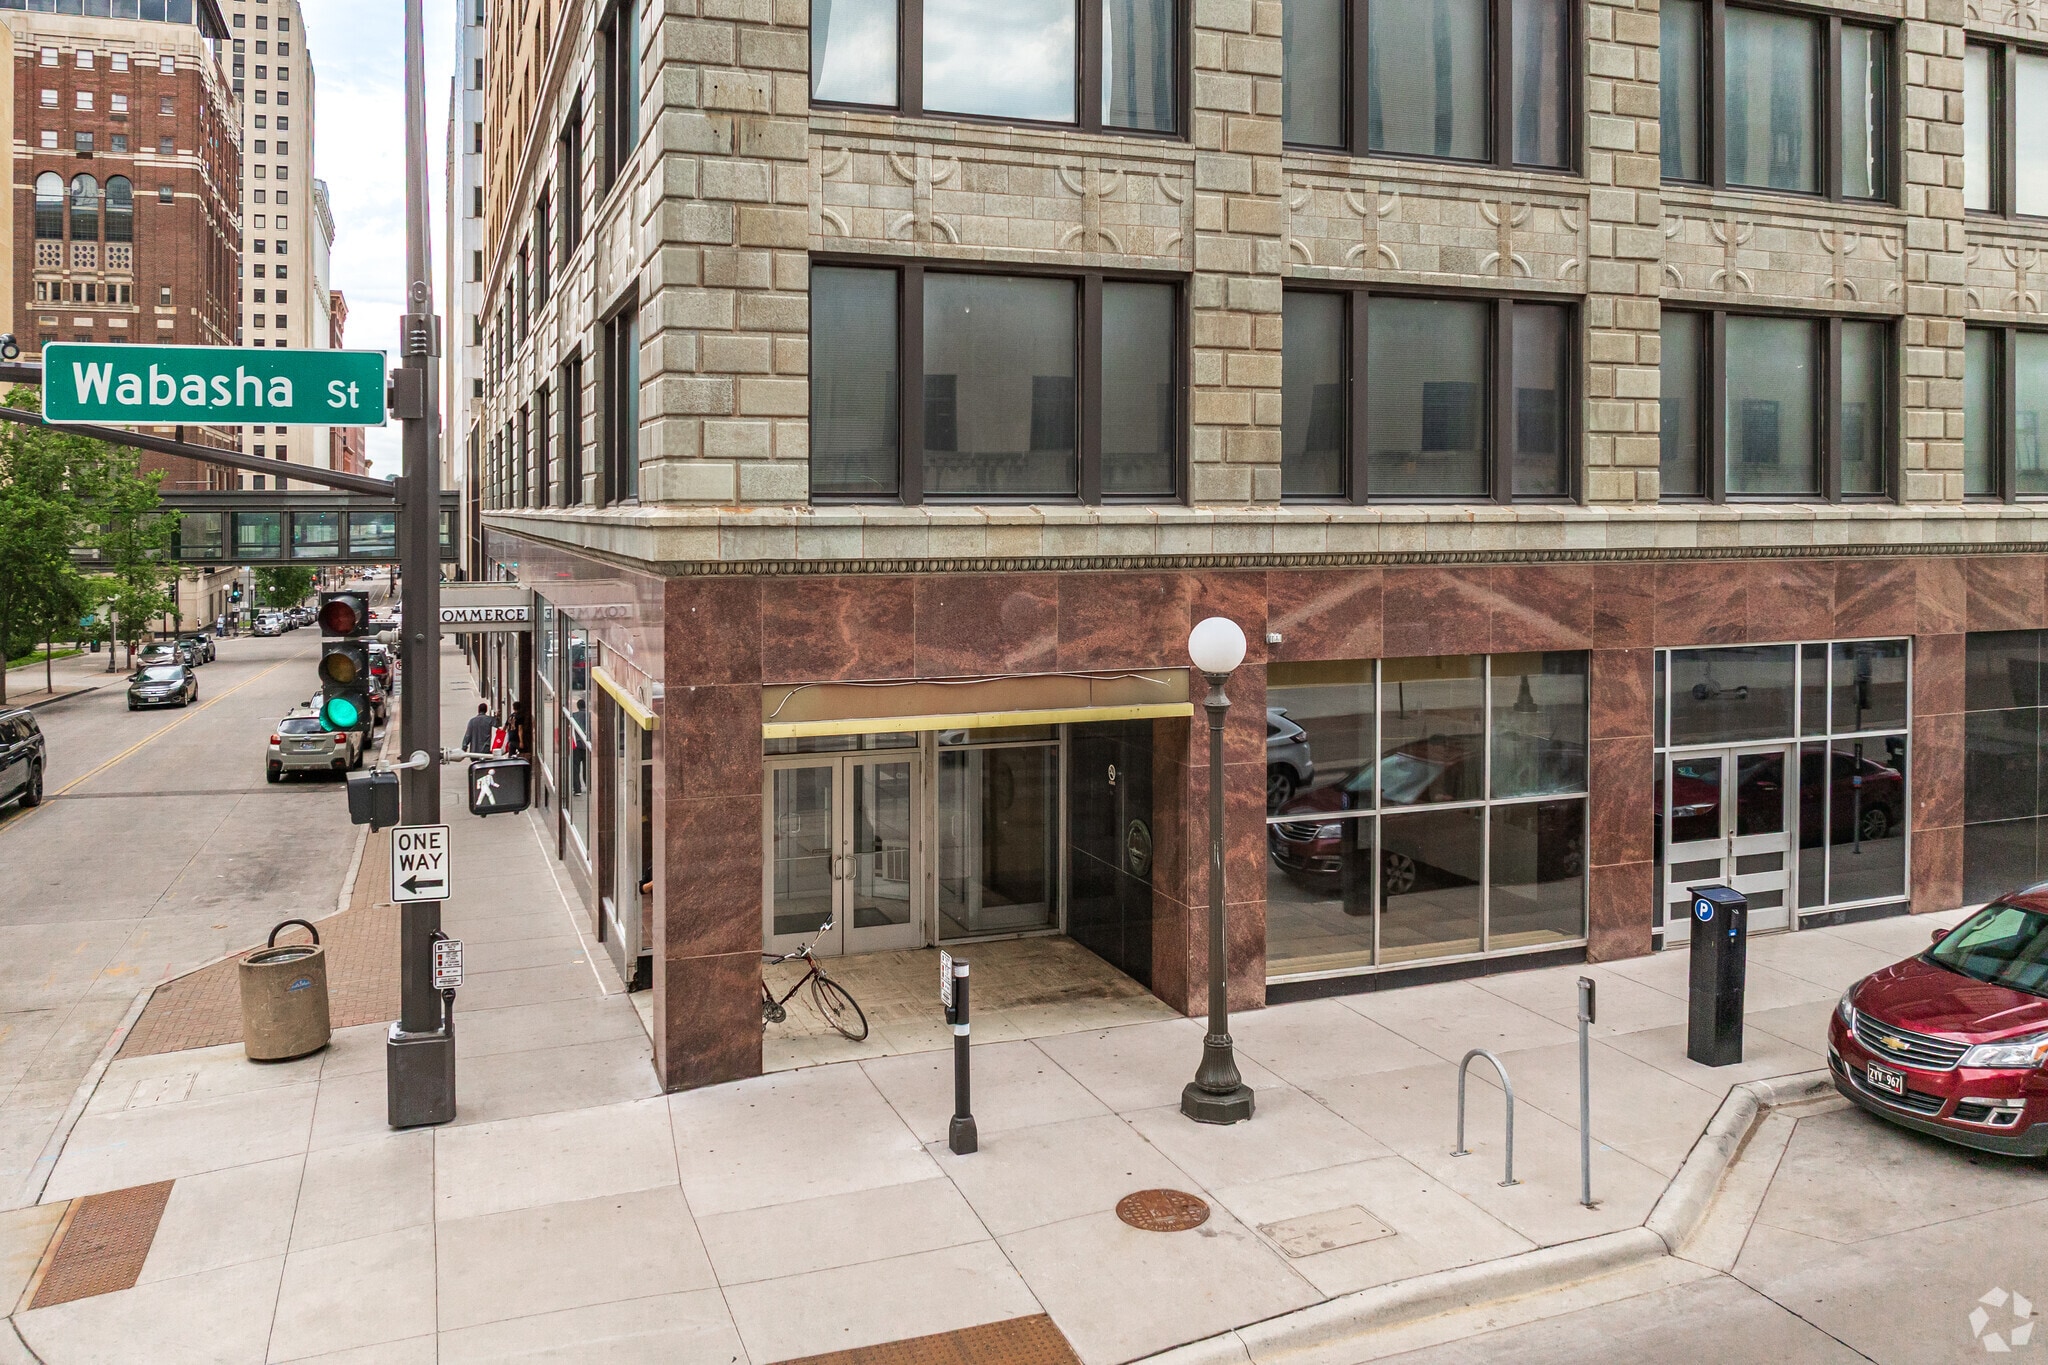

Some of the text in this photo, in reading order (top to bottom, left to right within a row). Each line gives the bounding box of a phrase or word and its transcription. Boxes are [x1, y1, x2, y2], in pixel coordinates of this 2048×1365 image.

[72, 361, 359, 409] Wabasha St
[441, 608, 526, 622] OMMERCE
[398, 832, 441, 851] ONE
[399, 852, 443, 871] WAY
[1699, 902, 1709, 917] P
[1886, 1074, 1900, 1088] 967
